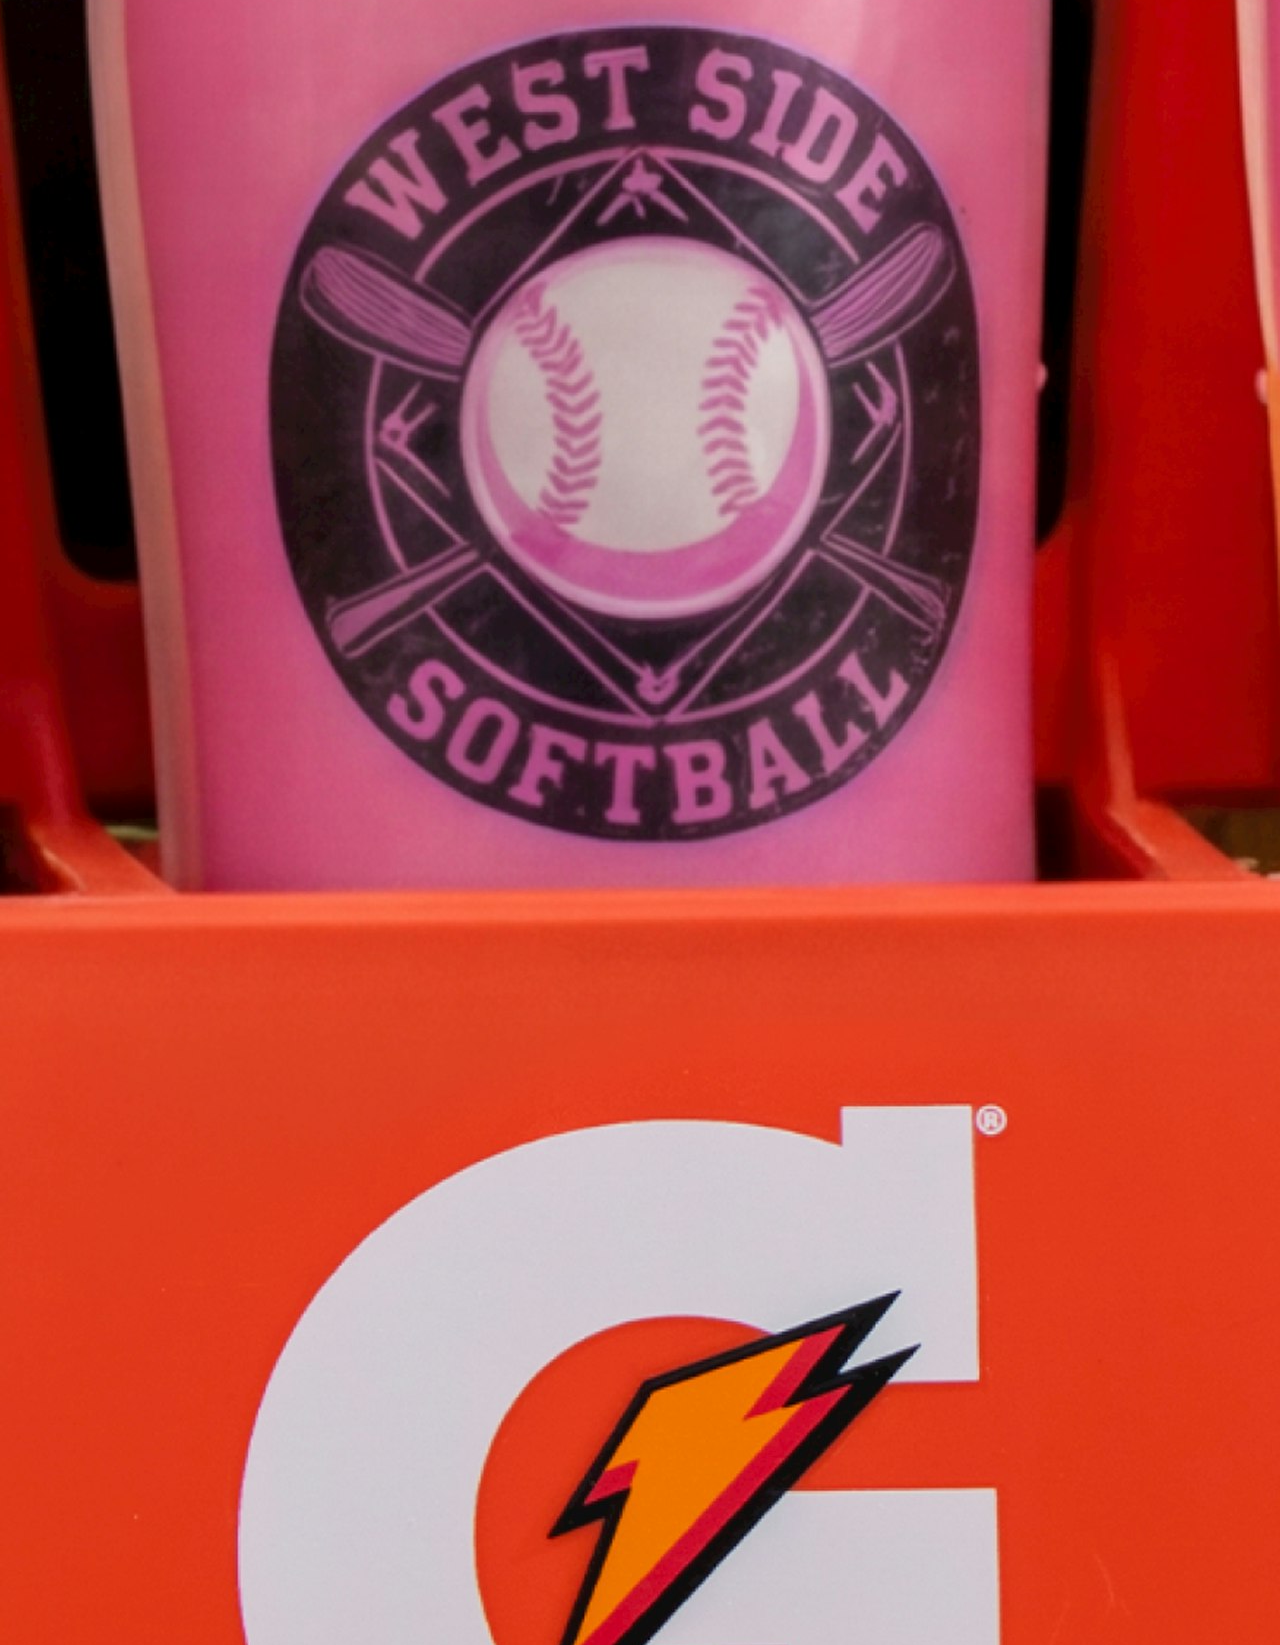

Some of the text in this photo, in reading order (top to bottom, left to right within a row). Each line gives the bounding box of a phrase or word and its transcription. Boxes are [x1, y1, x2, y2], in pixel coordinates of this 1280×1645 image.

[344, 45, 909, 241] WEST SIDE
[386, 648, 910, 826] SOFTBALL
